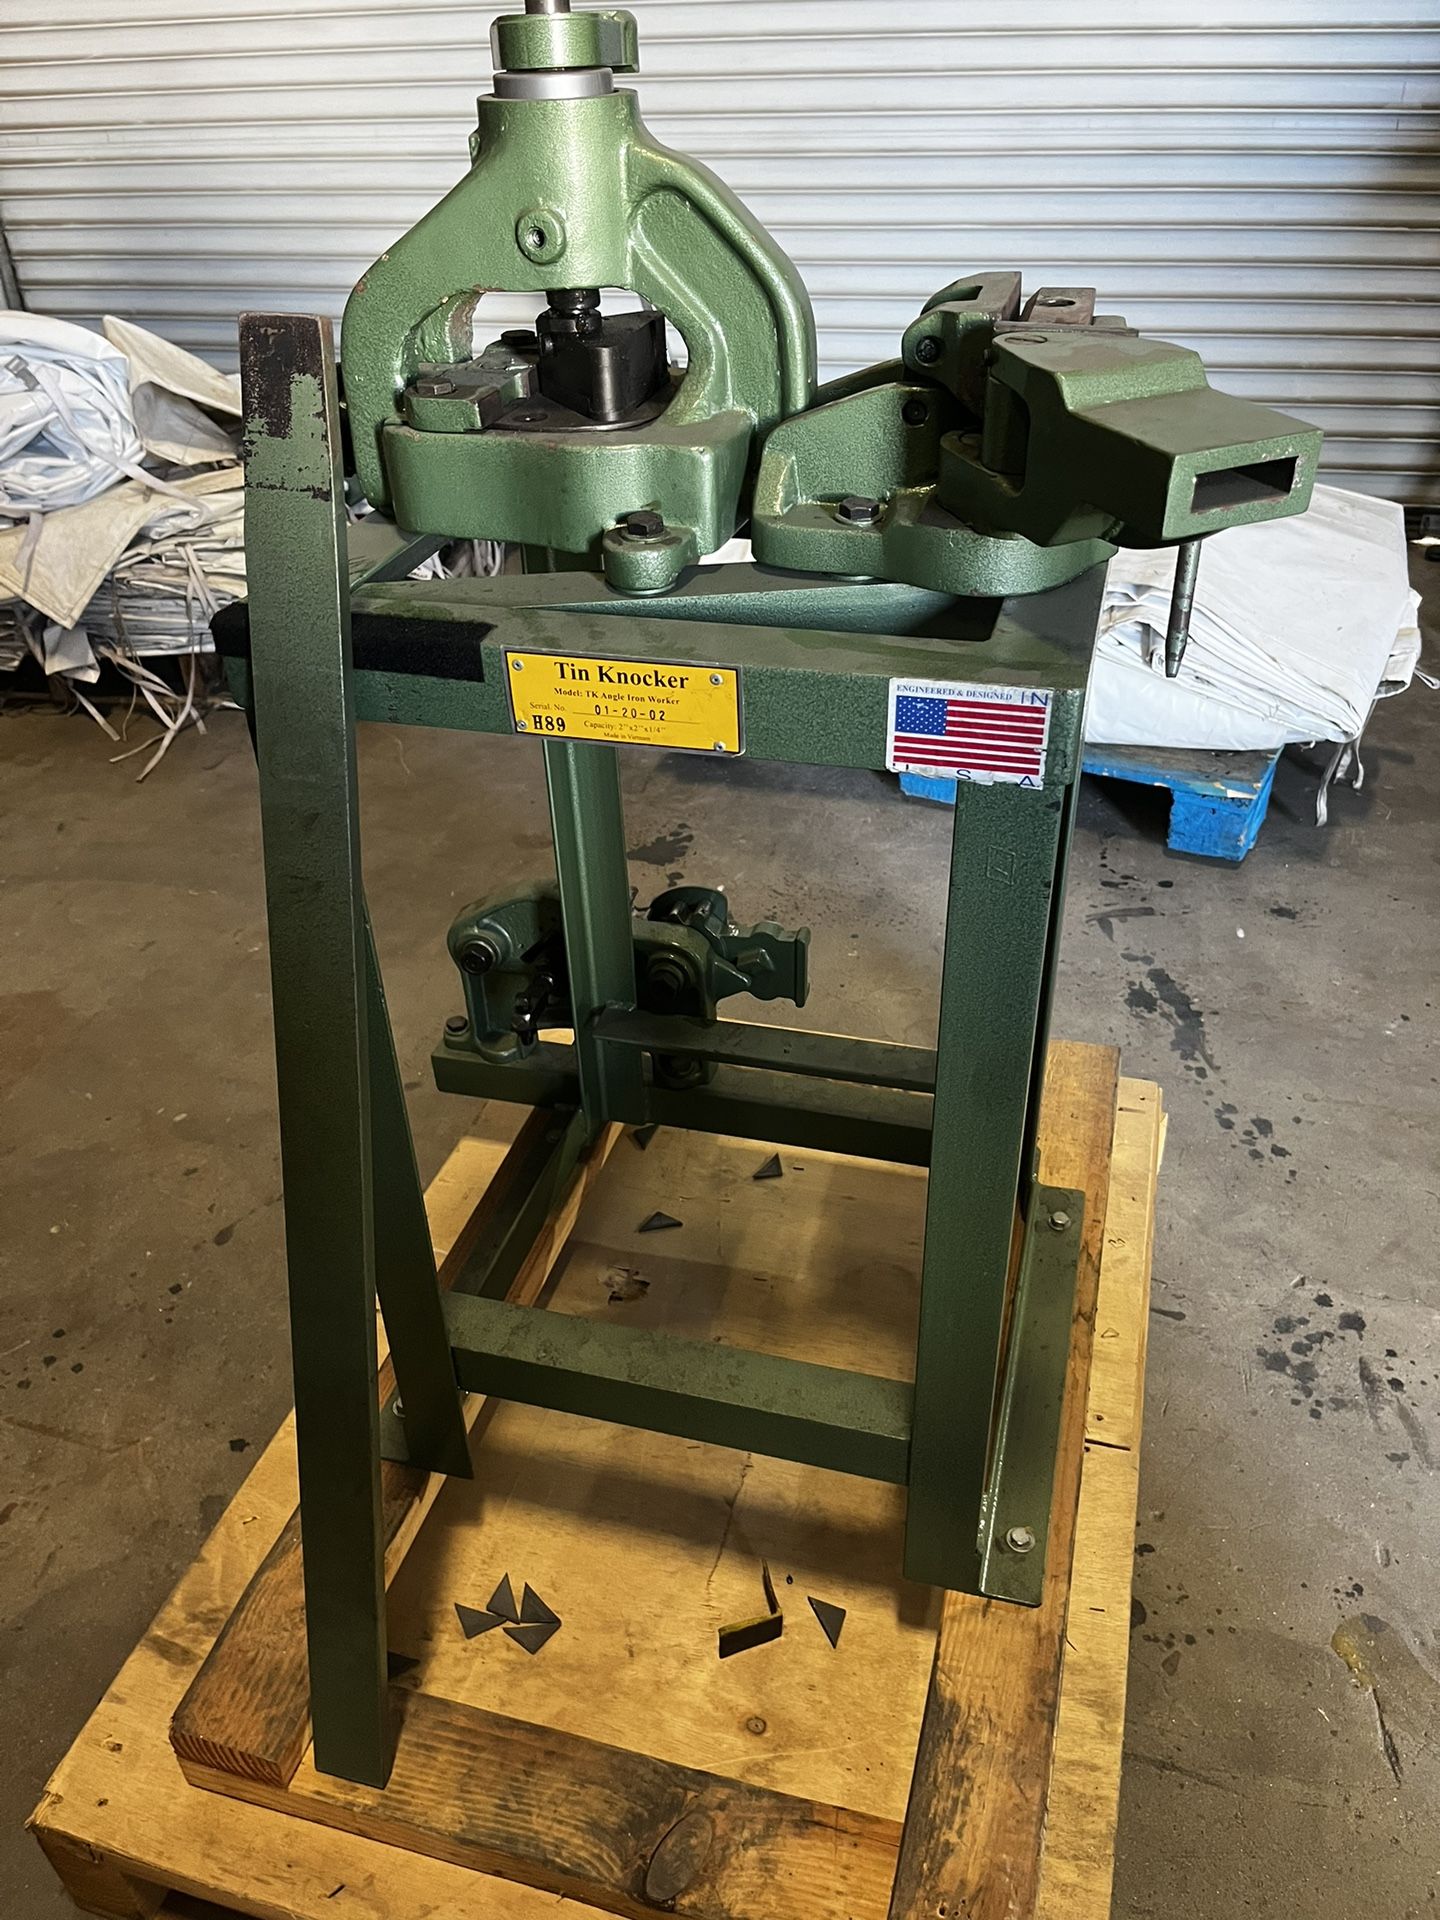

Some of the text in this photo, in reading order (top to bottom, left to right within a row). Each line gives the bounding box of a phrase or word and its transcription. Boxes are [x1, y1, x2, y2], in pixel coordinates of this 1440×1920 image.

[554, 661, 689, 689] Tin Knocker
[554, 687, 680, 705] Model: TK Angle Iron Worker
[896, 684, 955, 696] ENGINEERED
[966, 690, 1013, 701] DESIGNED
[594, 704, 665, 721] 01-20-02
[532, 715, 566, 732] H89
